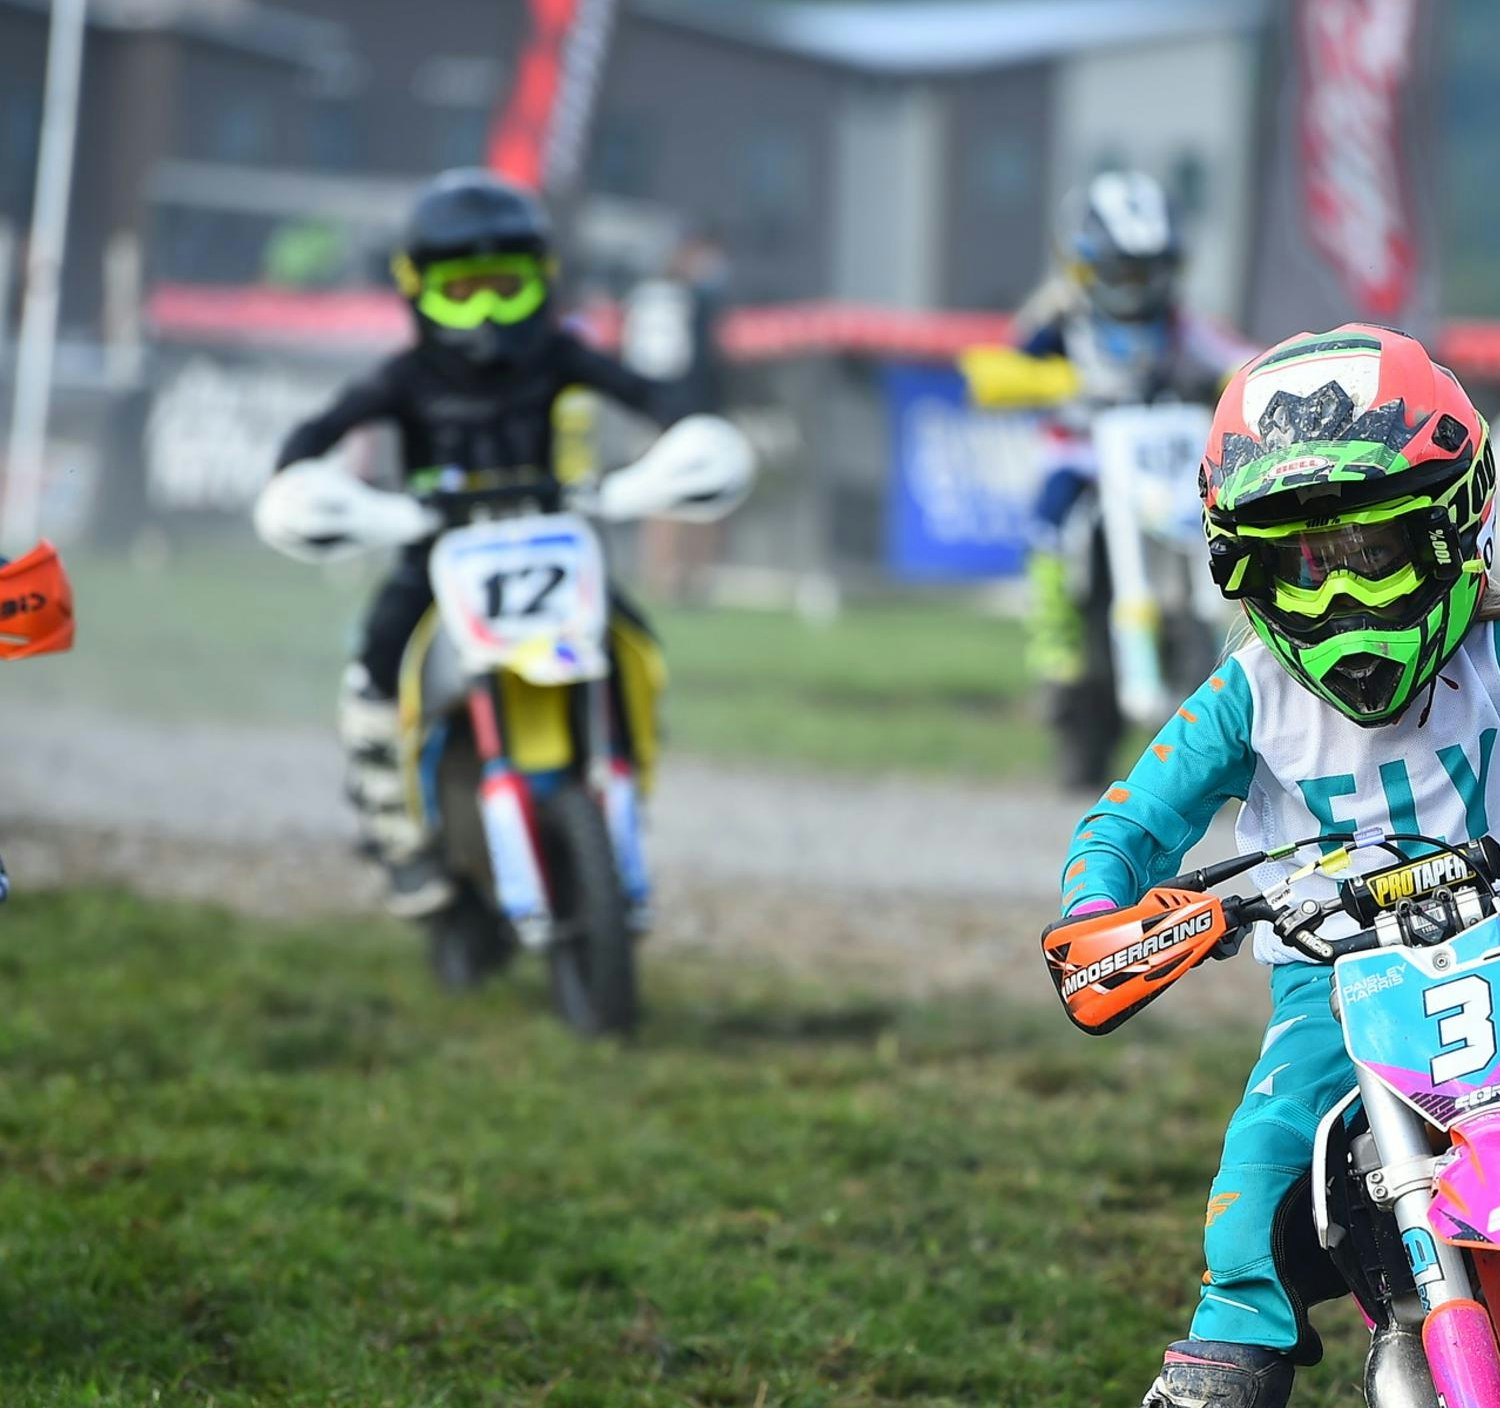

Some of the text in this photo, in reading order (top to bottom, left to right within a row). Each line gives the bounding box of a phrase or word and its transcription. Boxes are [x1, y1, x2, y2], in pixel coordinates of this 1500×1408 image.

[1276, 459, 1318, 474] BELL
[1429, 528, 1452, 565] 100%
[1296, 727, 1498, 859] FLY
[1422, 973, 1498, 1088] 3
